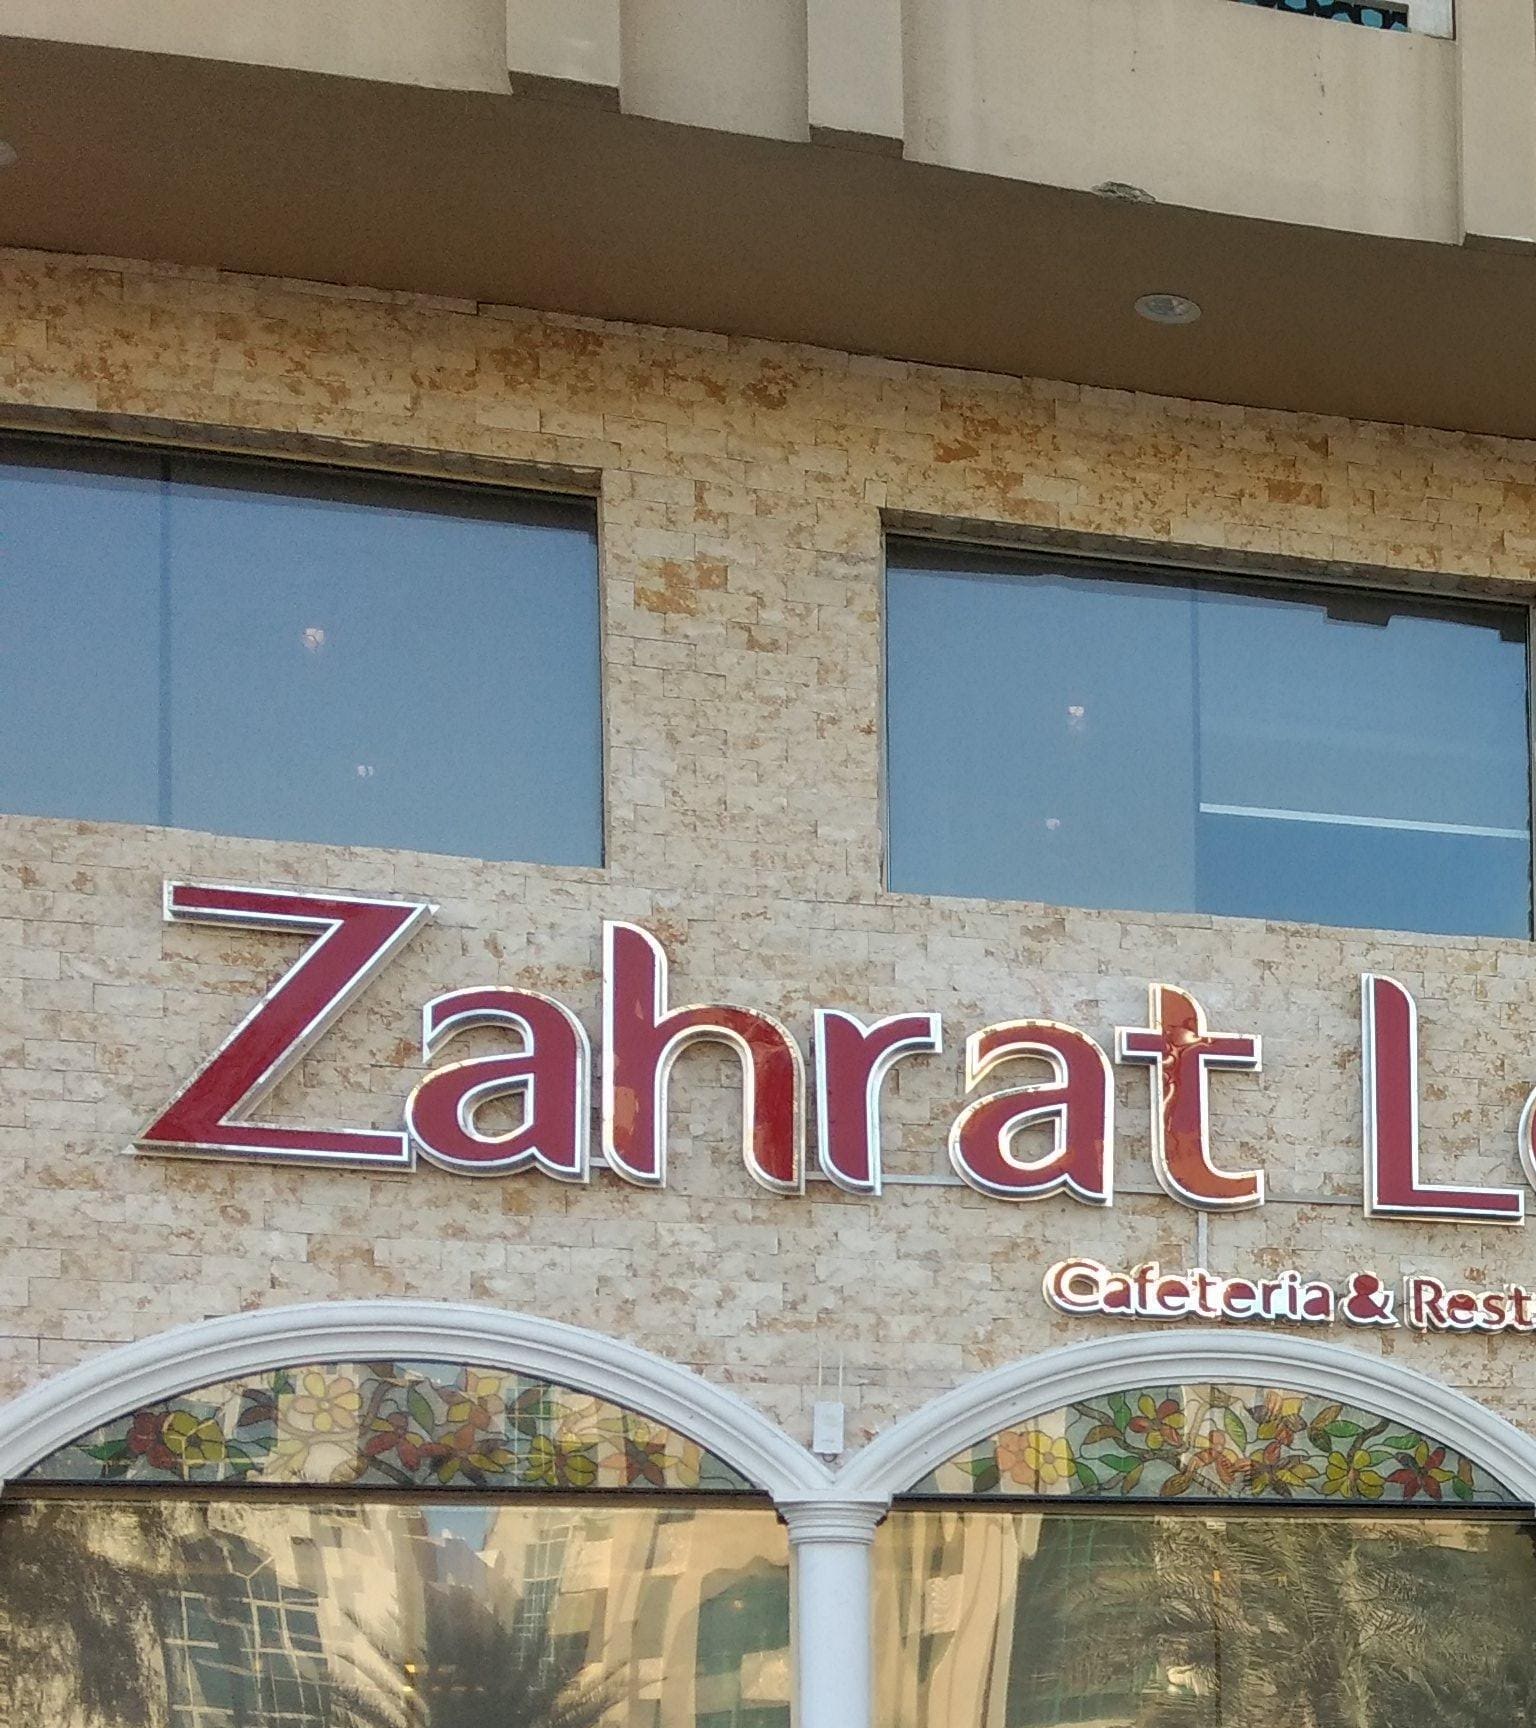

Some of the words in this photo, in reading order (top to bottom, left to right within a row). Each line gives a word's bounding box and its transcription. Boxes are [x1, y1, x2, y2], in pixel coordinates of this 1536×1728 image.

[127, 878, 1264, 1211] Zahrat
[1043, 1256, 1335, 1322] Cafeteria
[1344, 1270, 1400, 1328] &
